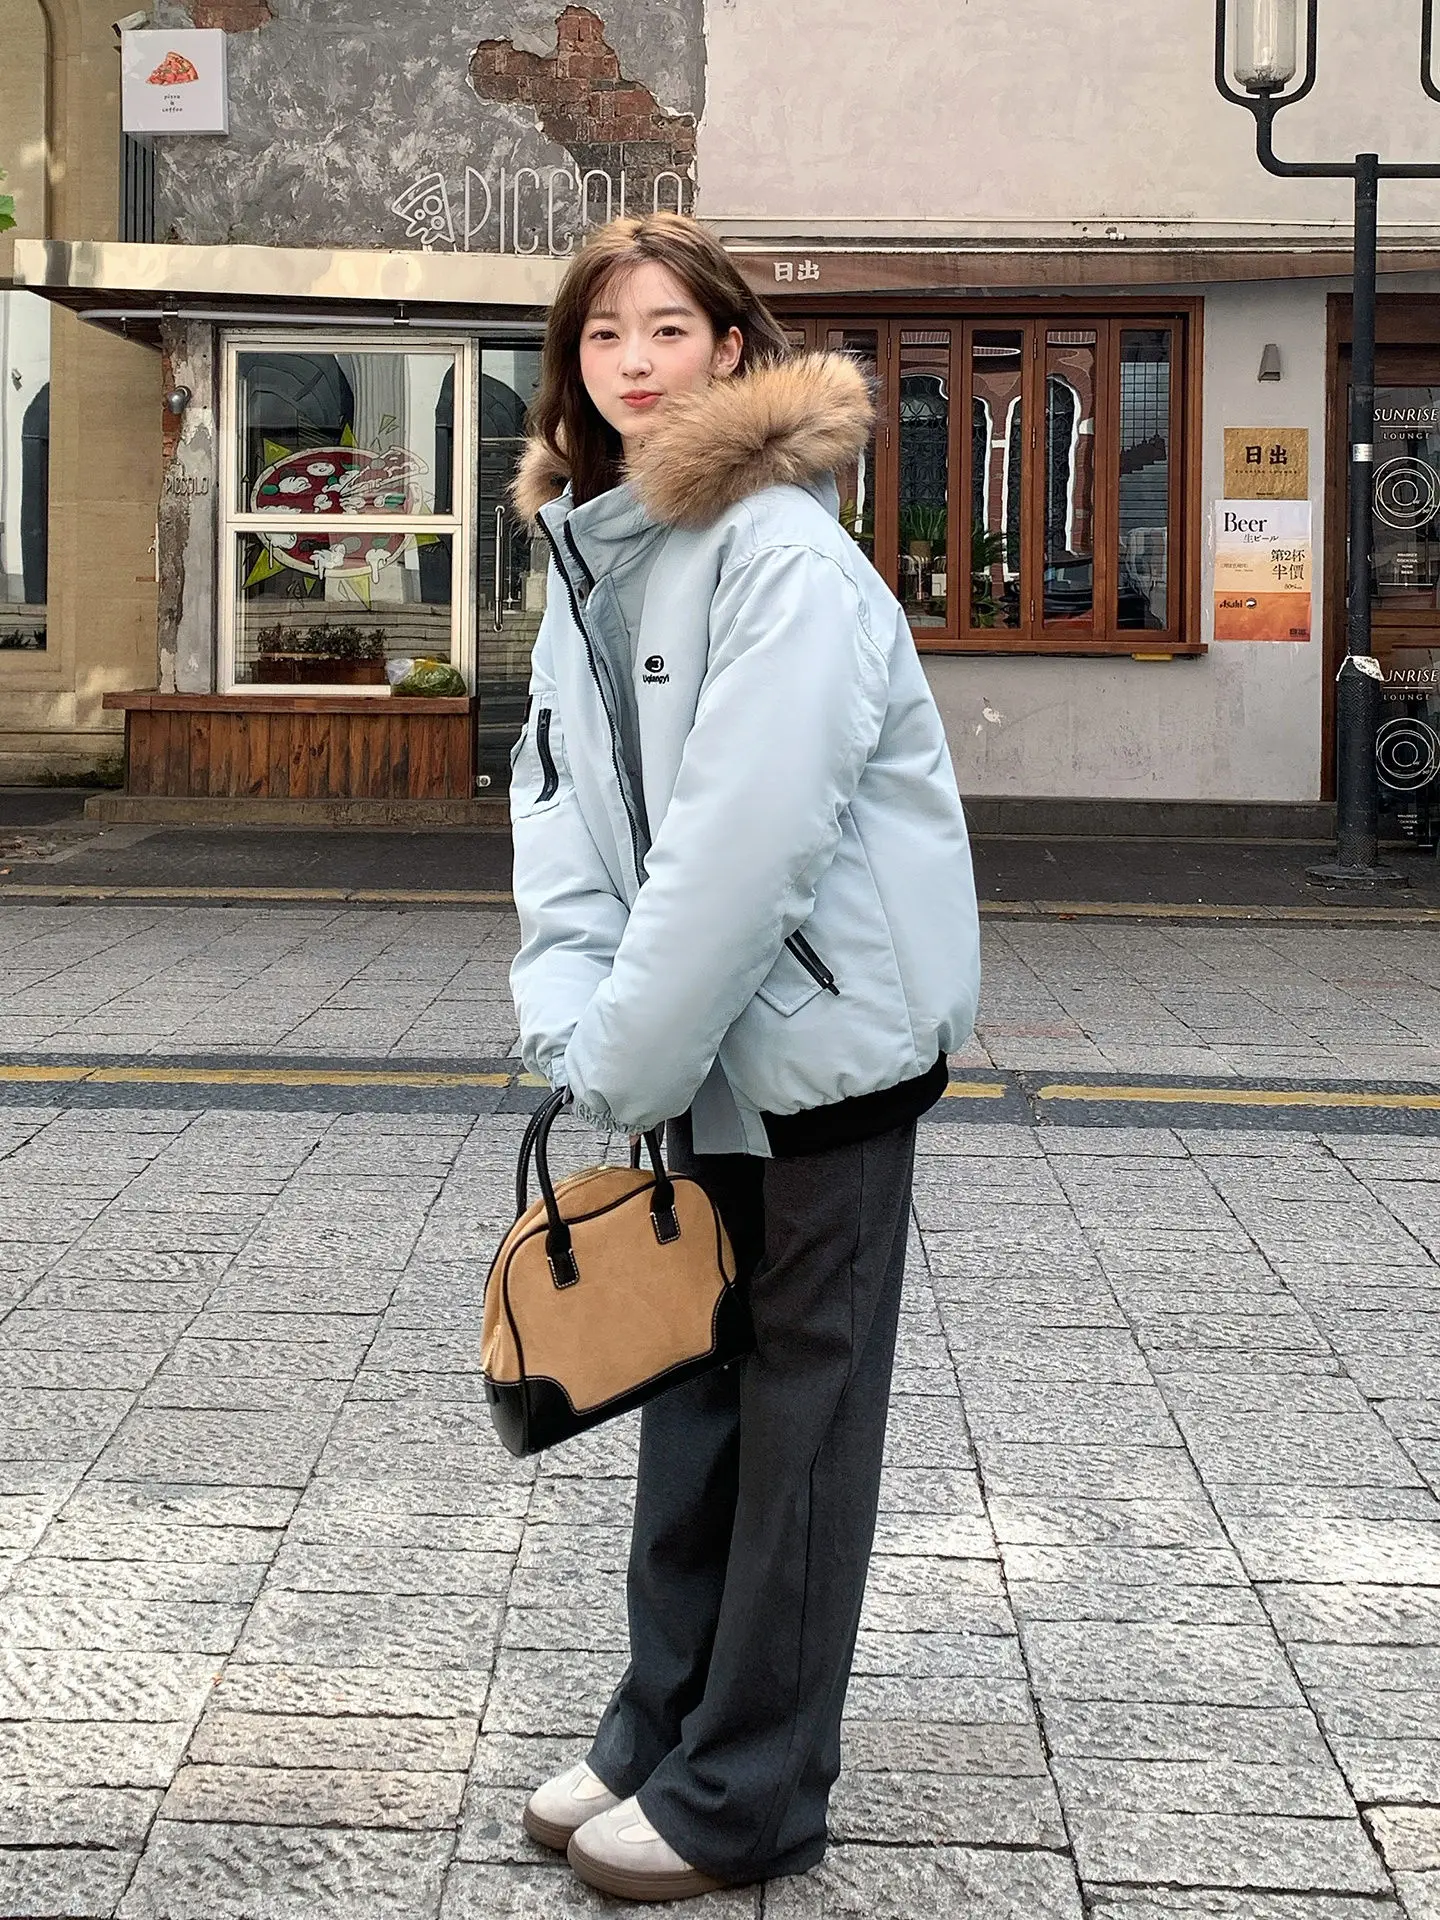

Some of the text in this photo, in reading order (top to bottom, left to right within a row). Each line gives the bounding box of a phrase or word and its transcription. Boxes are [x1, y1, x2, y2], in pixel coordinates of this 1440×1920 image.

[773, 259, 820, 282] 日出
[1373, 408, 1439, 422] SUNRISE
[1383, 432, 1430, 440] LOUNGE
[1245, 444, 1288, 465] 日出
[1223, 512, 1267, 532] Beer
[1243, 533, 1279, 543] 生ビール
[1270, 548, 1305, 562] 第2杯
[1272, 563, 1304, 580] 半價
[1219, 600, 1243, 609] Asahi
[1383, 669, 1439, 682] UNRISE
[1383, 693, 1430, 701] LOUNGE
